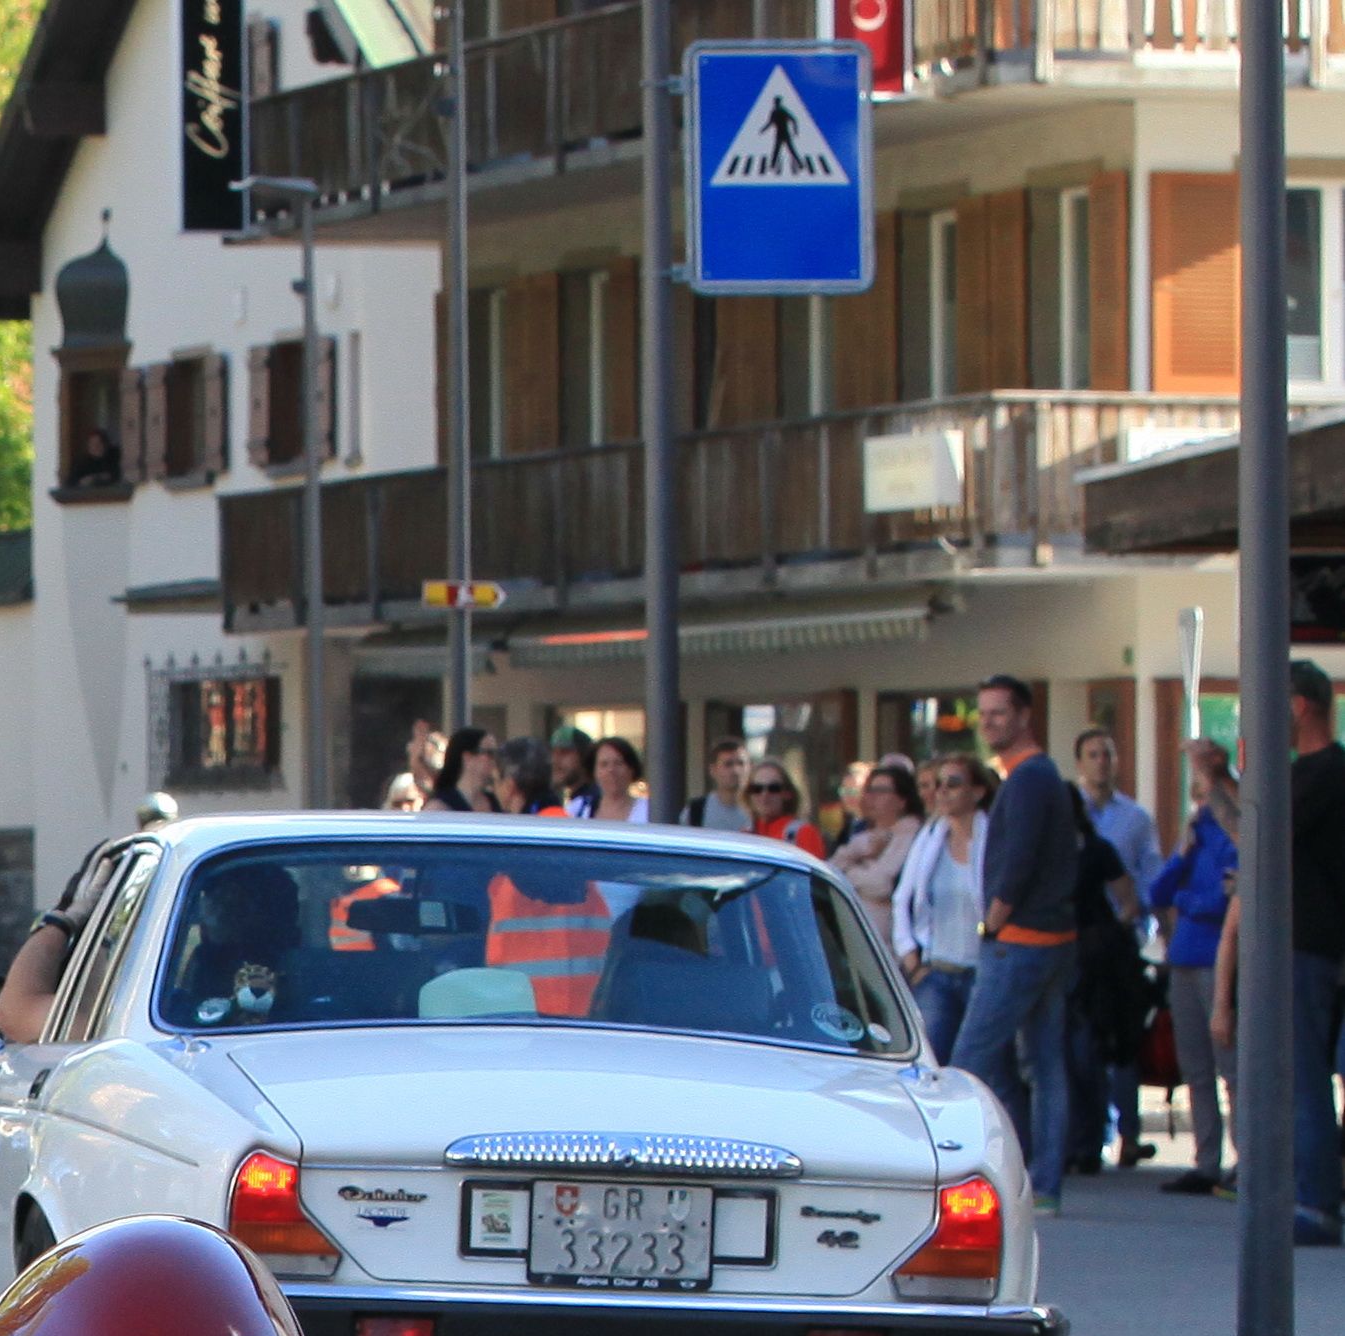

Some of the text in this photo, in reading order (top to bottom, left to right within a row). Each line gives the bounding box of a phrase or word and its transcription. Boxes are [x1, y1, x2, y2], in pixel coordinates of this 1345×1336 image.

[603, 1187, 643, 1221] GR
[557, 1228, 686, 1275] 33233
[576, 1276, 659, 1289] Alpina Chur AG
